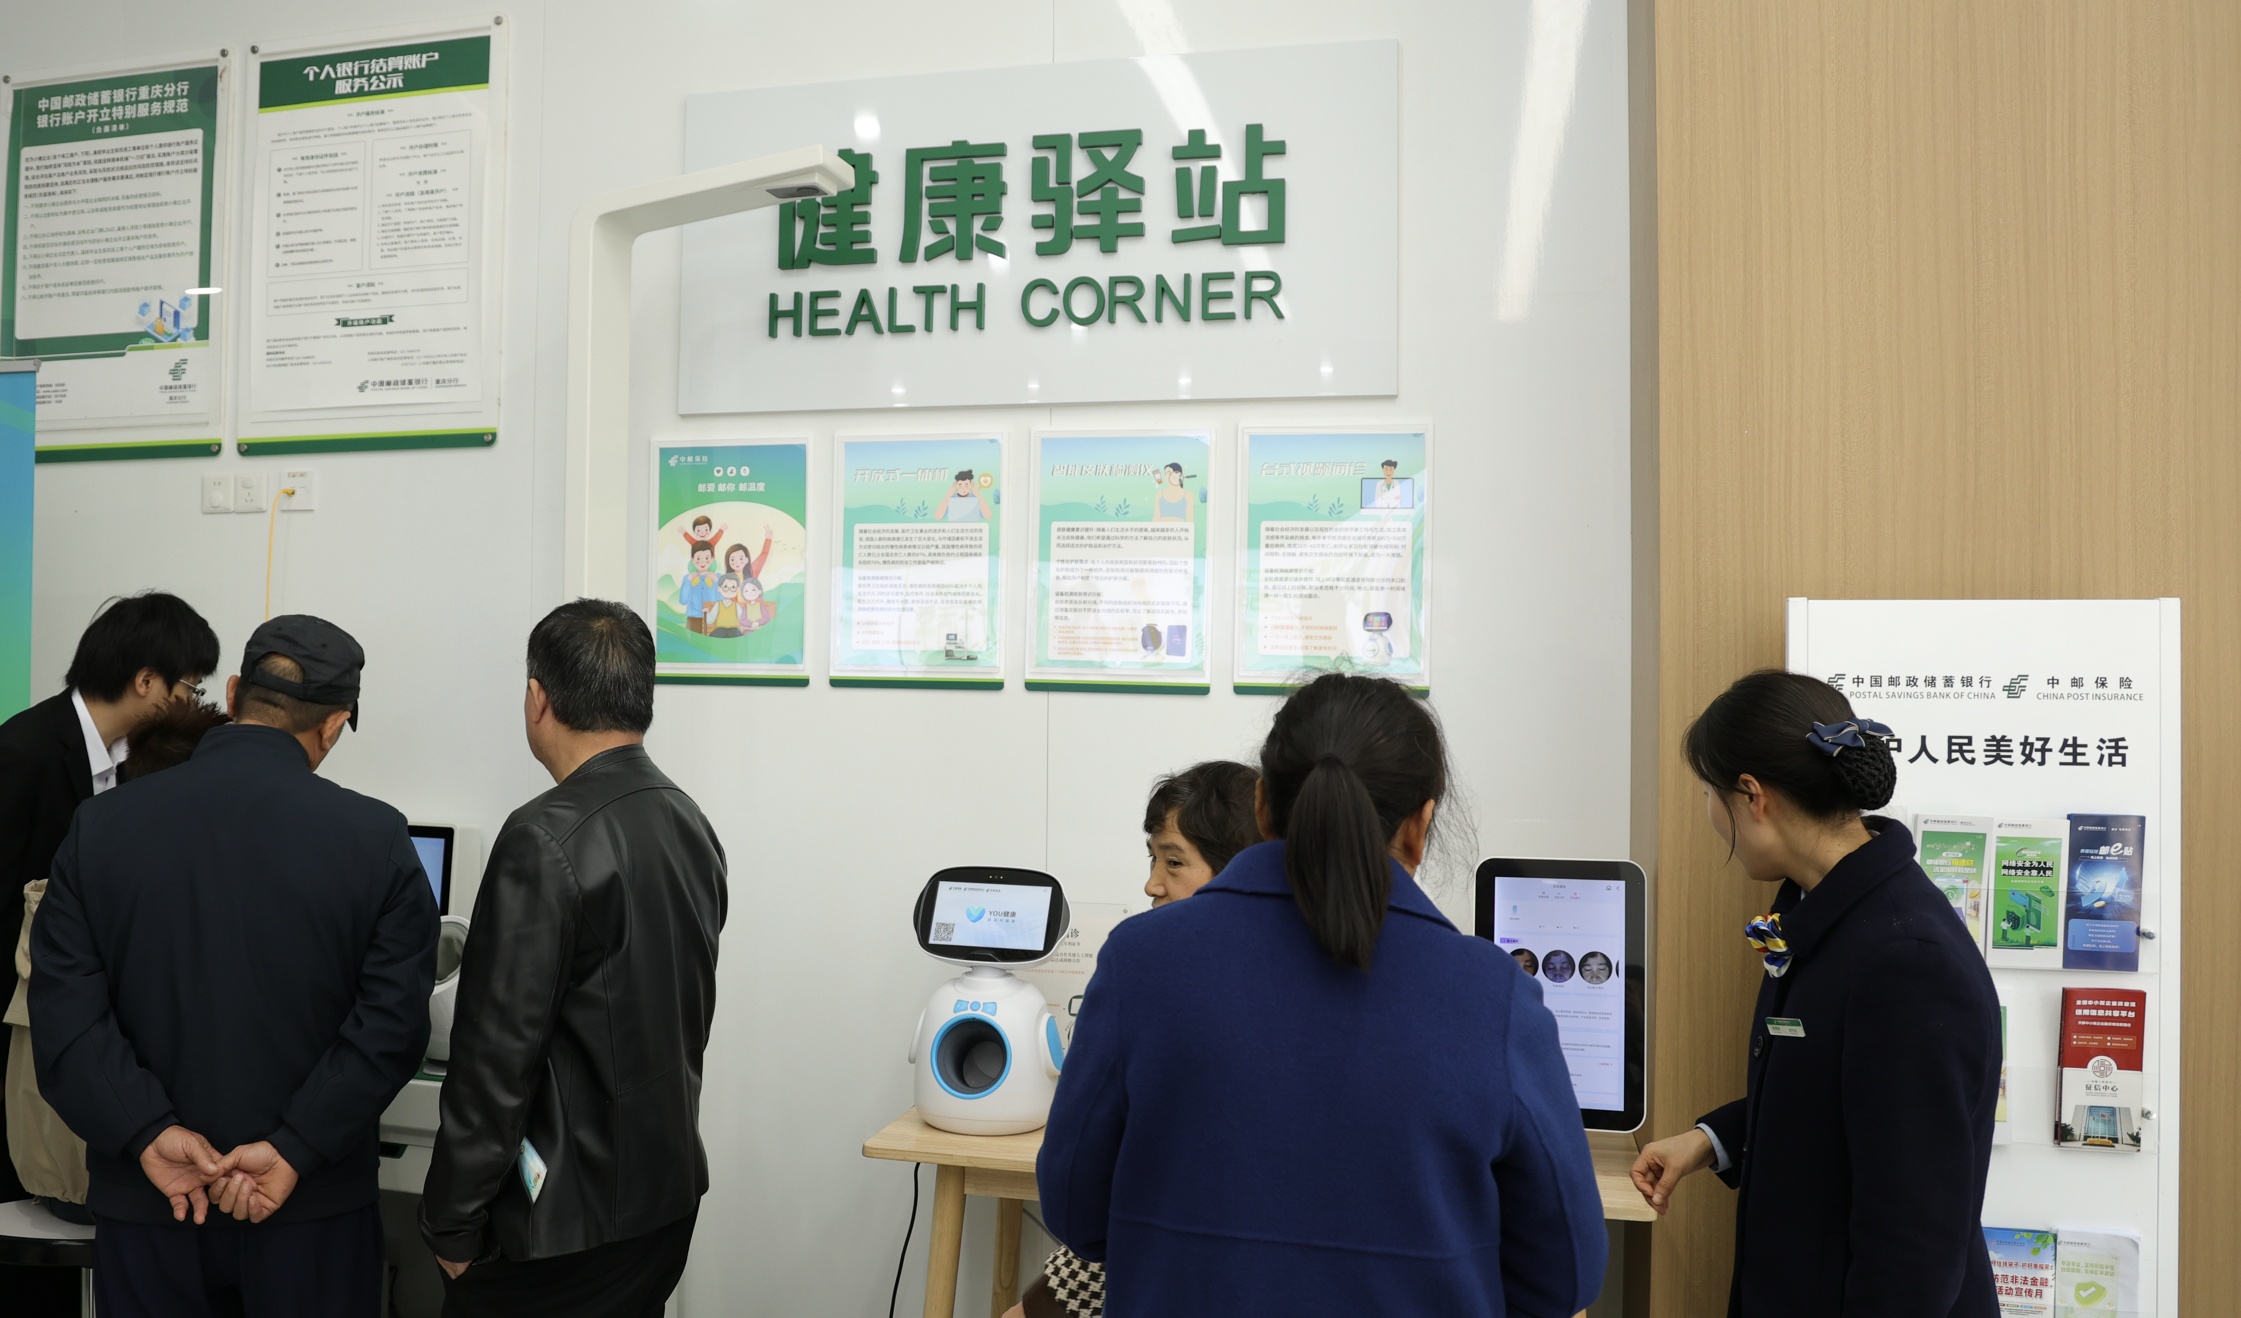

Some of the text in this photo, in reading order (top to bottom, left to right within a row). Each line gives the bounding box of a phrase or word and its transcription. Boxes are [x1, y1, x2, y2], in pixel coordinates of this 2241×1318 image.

[303, 52, 440, 82] 个人银行结算账户
[335, 73, 404, 95] 服务公示
[37, 81, 190, 112] 中国邮政储蓄银行重庆分行
[36, 98, 190, 129] 银行账户开立特别服务规范
[777, 123, 1287, 271] 健康驿站
[768, 270, 1285, 338] HEALTH CORNER
[854, 468, 949, 483] 开放式一体机
[1052, 464, 1154, 477] 智能皮肤检测仪
[1260, 462, 1367, 477] 台式视频问诊
[698, 481, 766, 493] 邮爱 邮你 邮温度
[1852, 675, 2133, 689] 中国邮政储蓄银行 中邮保险
[1849, 691, 1996, 700] POSTAL SAVINGS BANK OF CHINA
[2036, 692, 2144, 701] CHINA POST INSURANCE
[2001, 860, 2054, 868] 网络安全为人民
[2001, 868, 2053, 877] 网络安全靠人民
[988, 910, 1017, 918] YOU健康
[2085, 1083, 2119, 1092] 征信中心
